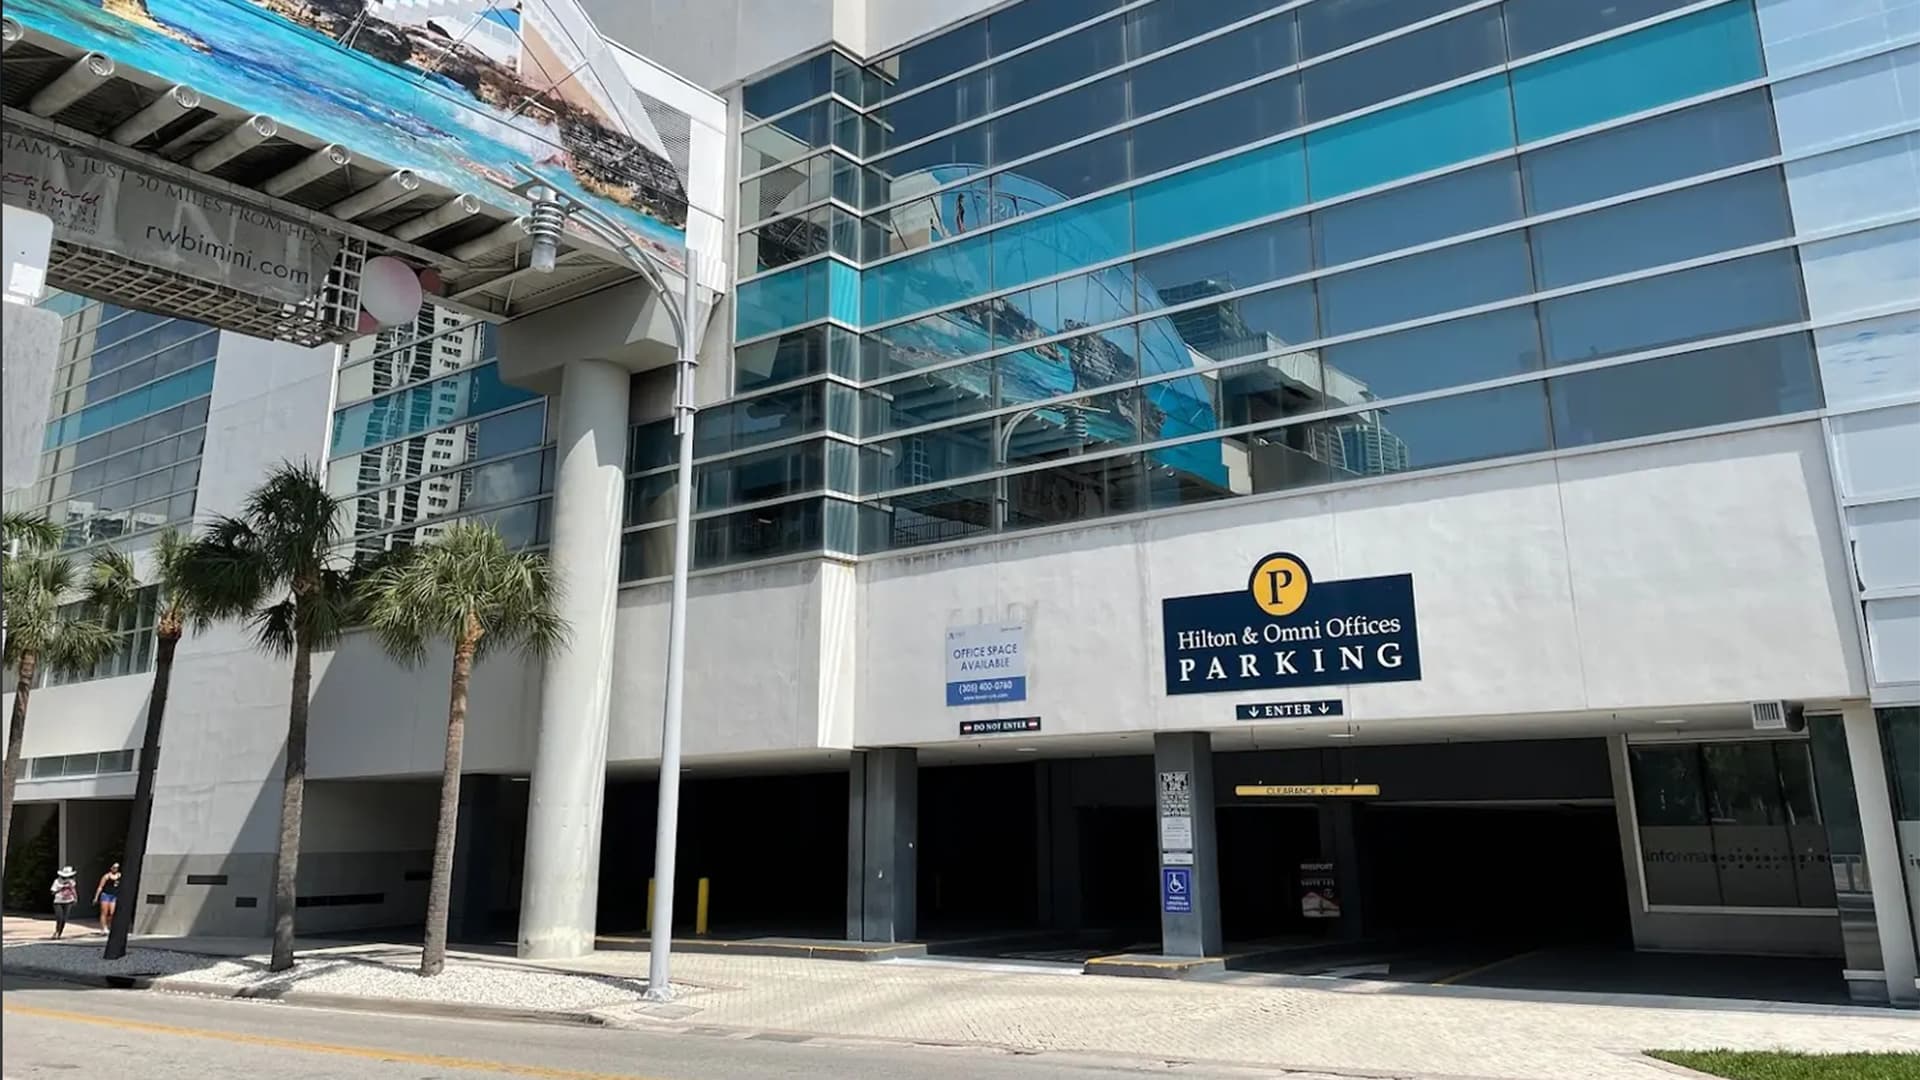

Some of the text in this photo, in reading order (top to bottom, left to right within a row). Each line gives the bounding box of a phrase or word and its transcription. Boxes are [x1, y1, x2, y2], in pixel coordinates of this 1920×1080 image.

[28, 189, 97, 218] BIMINI
[82, 157, 128, 182] JUST
[165, 184, 224, 213] MILES
[230, 202, 282, 233] FROM
[146, 224, 310, 285] rwbimini.com
[1266, 569, 1293, 606] P
[1178, 616, 1401, 650] Hilton & Omni Offices
[953, 643, 1017, 660] OFFICE SPACE
[960, 657, 1010, 672] AVAILABLE
[1179, 643, 1402, 682] PARKING
[1265, 704, 1313, 717] ENTER
[973, 720, 1027, 732] DO NOT ENTER
[1266, 786, 1317, 795] CLEARANCE
